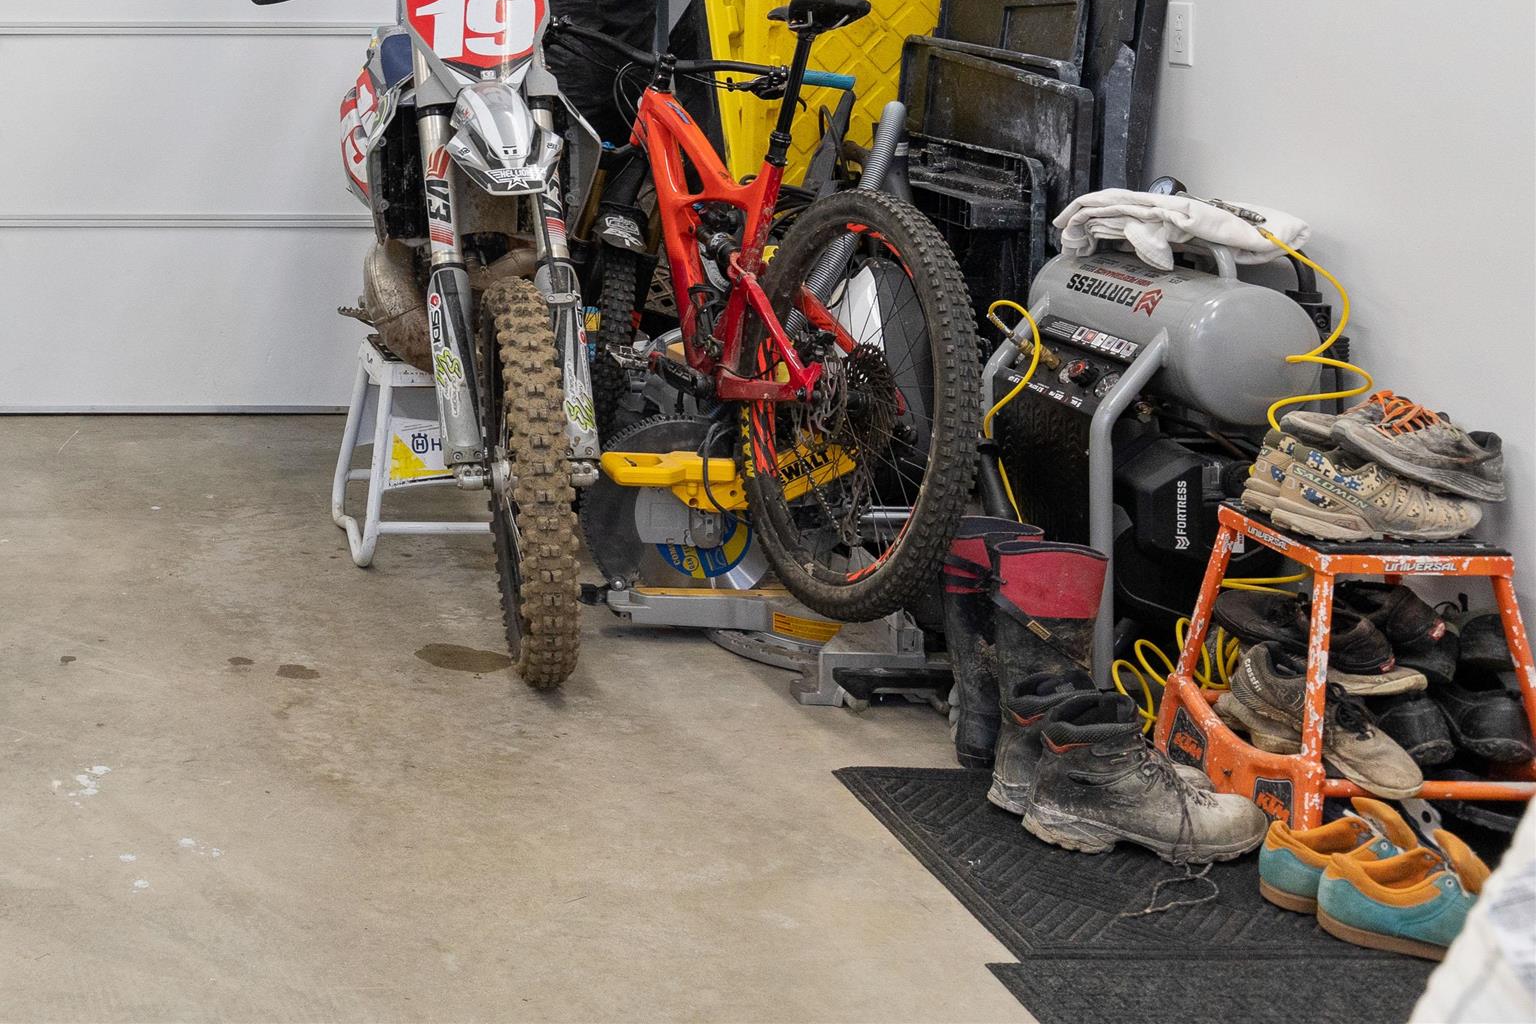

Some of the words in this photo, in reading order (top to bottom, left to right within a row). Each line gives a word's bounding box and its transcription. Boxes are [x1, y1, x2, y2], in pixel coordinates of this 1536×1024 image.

[1066, 273, 1142, 307] FORTRESS
[430, 310, 441, 344] SIDI
[740, 405, 755, 478] MAXX
[778, 448, 831, 485] WALT
[1292, 466, 1368, 509] SALOMON
[1177, 480, 1187, 535] FORTRESS
[1247, 526, 1288, 551] UNIVERSAL
[1384, 562, 1458, 572] UNIVERSAL
[1244, 658, 1262, 693] CrossFit
[1256, 792, 1290, 823] KTM
